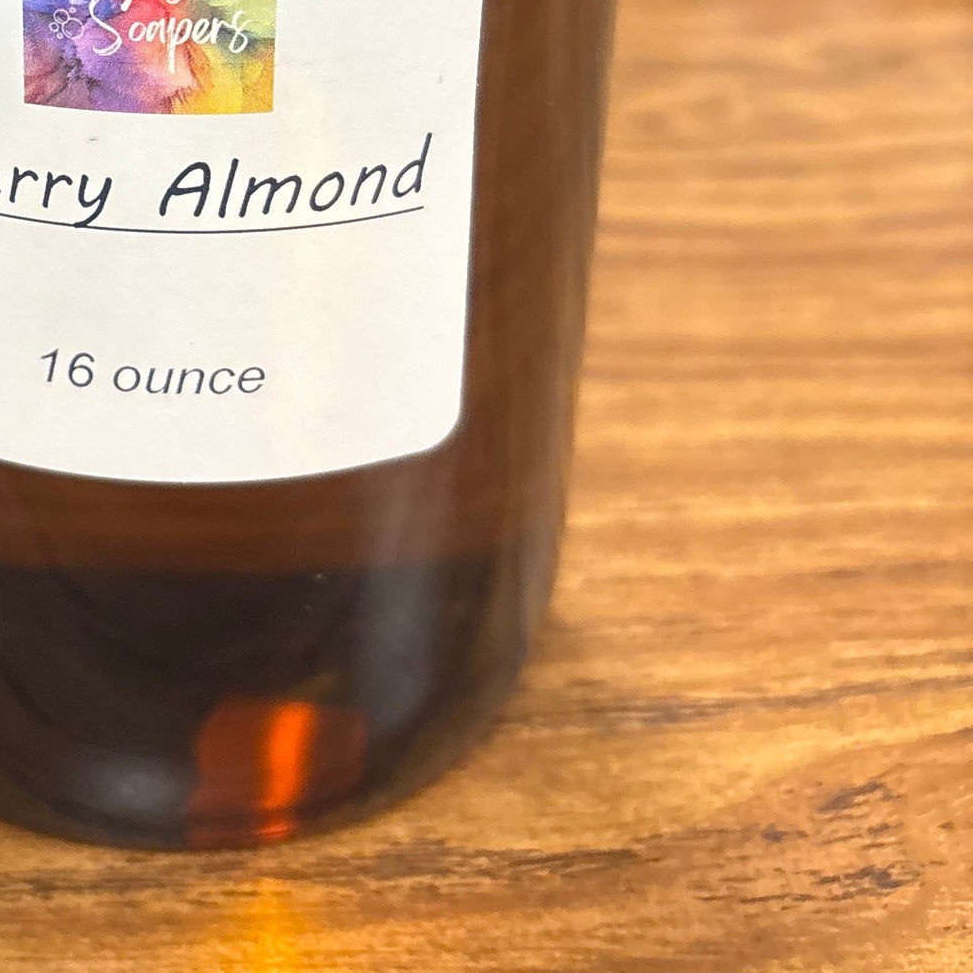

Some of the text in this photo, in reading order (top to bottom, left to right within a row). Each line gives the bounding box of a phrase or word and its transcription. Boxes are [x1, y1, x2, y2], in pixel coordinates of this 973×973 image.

[158, 132, 433, 219] Almond
[39, 348, 267, 395] 16 ounce
